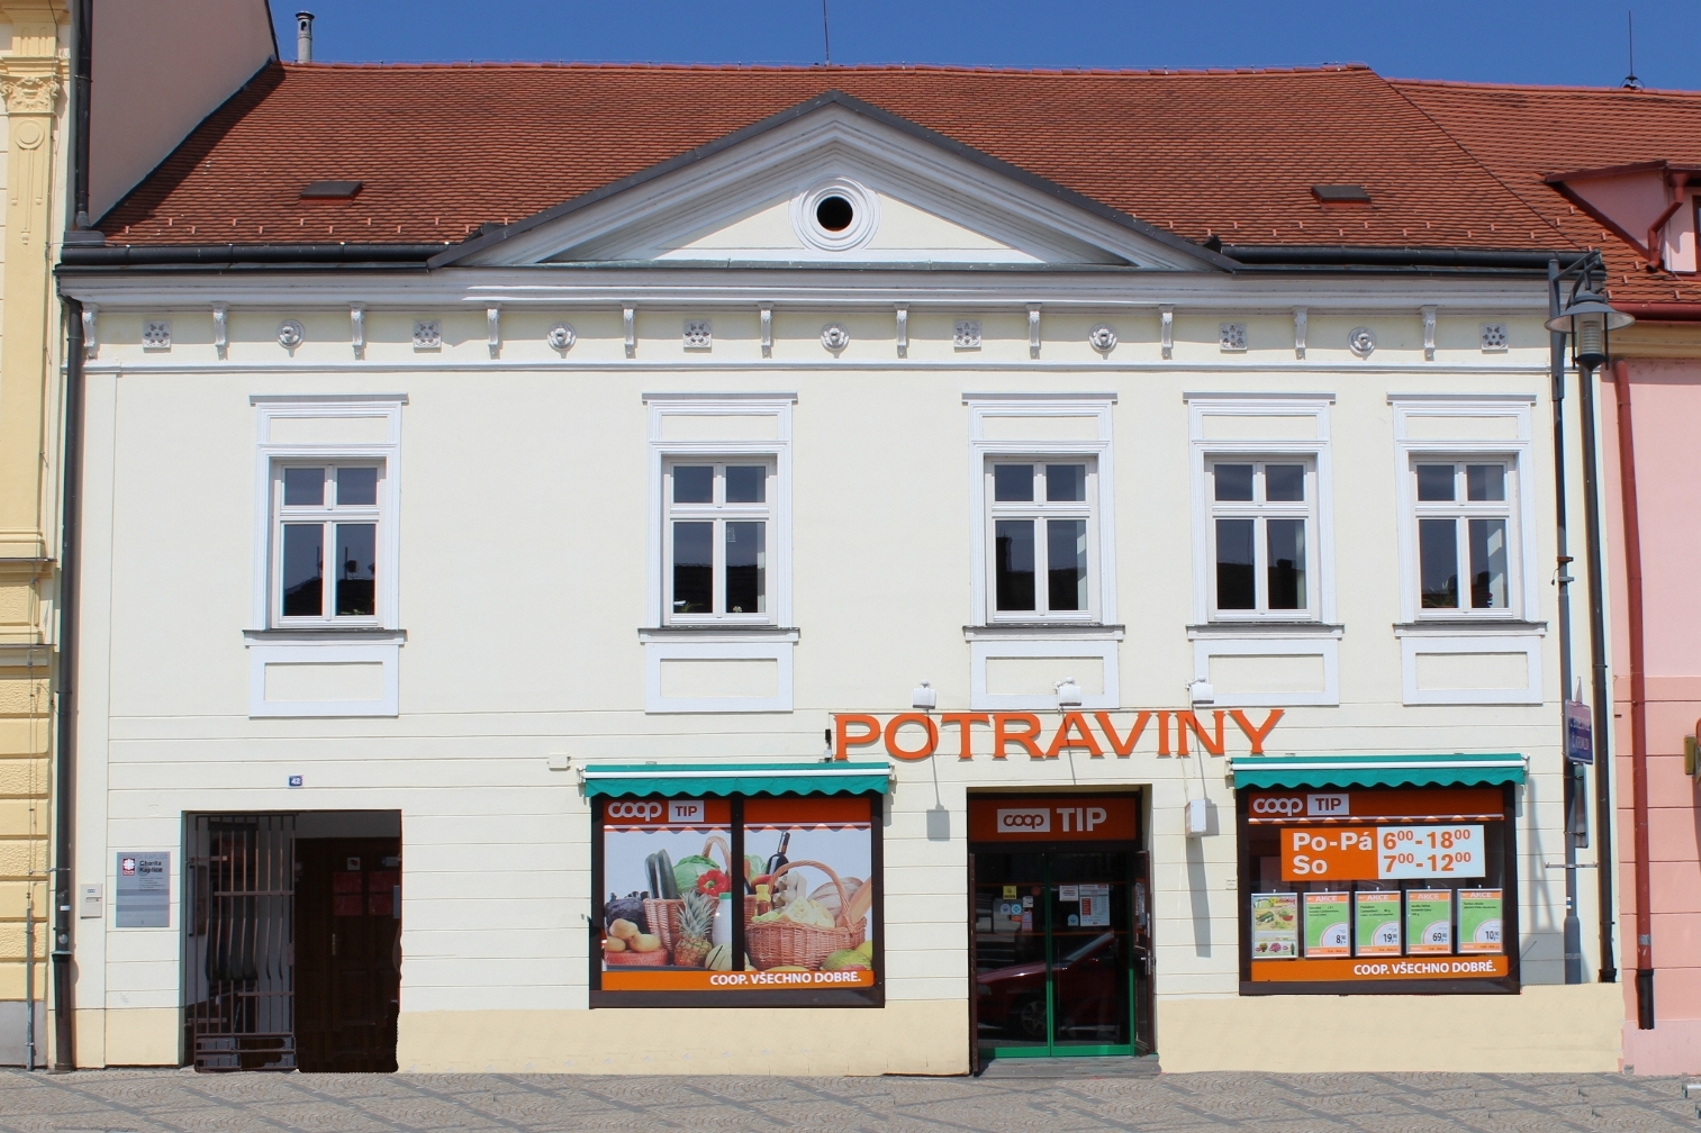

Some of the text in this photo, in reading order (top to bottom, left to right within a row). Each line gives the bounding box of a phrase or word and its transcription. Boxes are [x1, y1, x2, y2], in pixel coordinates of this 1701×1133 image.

[833, 708, 1285, 760] POTRAVINY
[608, 802, 698, 821] coop TIP
[1253, 797, 1342, 816] coop TIP
[1003, 807, 1107, 832] coop TIP
[1293, 831, 1373, 851] Po-Pá
[1293, 855, 1328, 875] So
[1353, 959, 1496, 975] COOP. VŠECHNO DOBRÉ.
[710, 971, 861, 986] COOP. VŠECHNO DOBRÉ.
